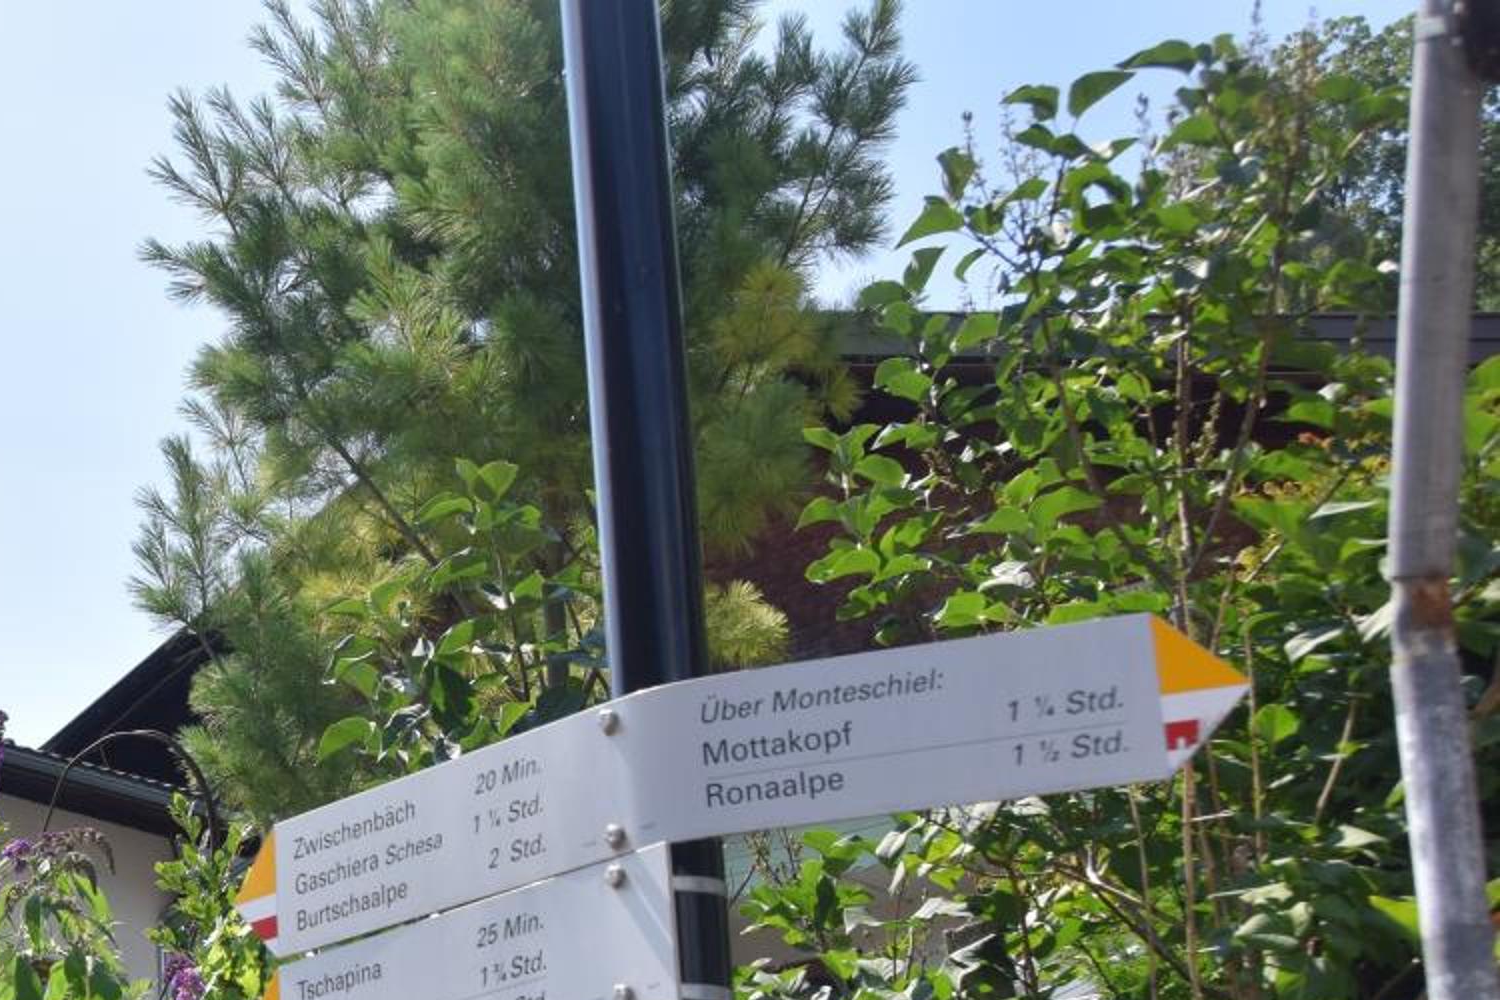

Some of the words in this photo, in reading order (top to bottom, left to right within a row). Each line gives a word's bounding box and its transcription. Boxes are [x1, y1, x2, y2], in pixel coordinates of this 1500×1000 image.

[701, 694, 763, 725] Über
[771, 667, 944, 714] Monteschiel:
[702, 721, 853, 767] Mottakopf
[1008, 700, 1018, 722] 1
[1066, 685, 1125, 715] Std.
[292, 800, 416, 861] Zwischenbäch
[475, 769, 497, 795] 20
[501, 757, 543, 785] Min.
[706, 772, 844, 808] Ronaalpe
[1014, 744, 1023, 766] 1
[1071, 730, 1129, 759] Std.
[295, 853, 379, 895] Gaschiera
[385, 834, 444, 866] Schesa
[474, 815, 480, 833] 1
[507, 793, 544, 823] Std.
[296, 882, 408, 931] Burtschaalpe
[488, 847, 500, 869] 2
[510, 833, 547, 862] Std.
[477, 922, 498, 948] 25
[503, 912, 544, 940] Min.
[482, 965, 487, 987] 1
[511, 949, 547, 979] Std.
